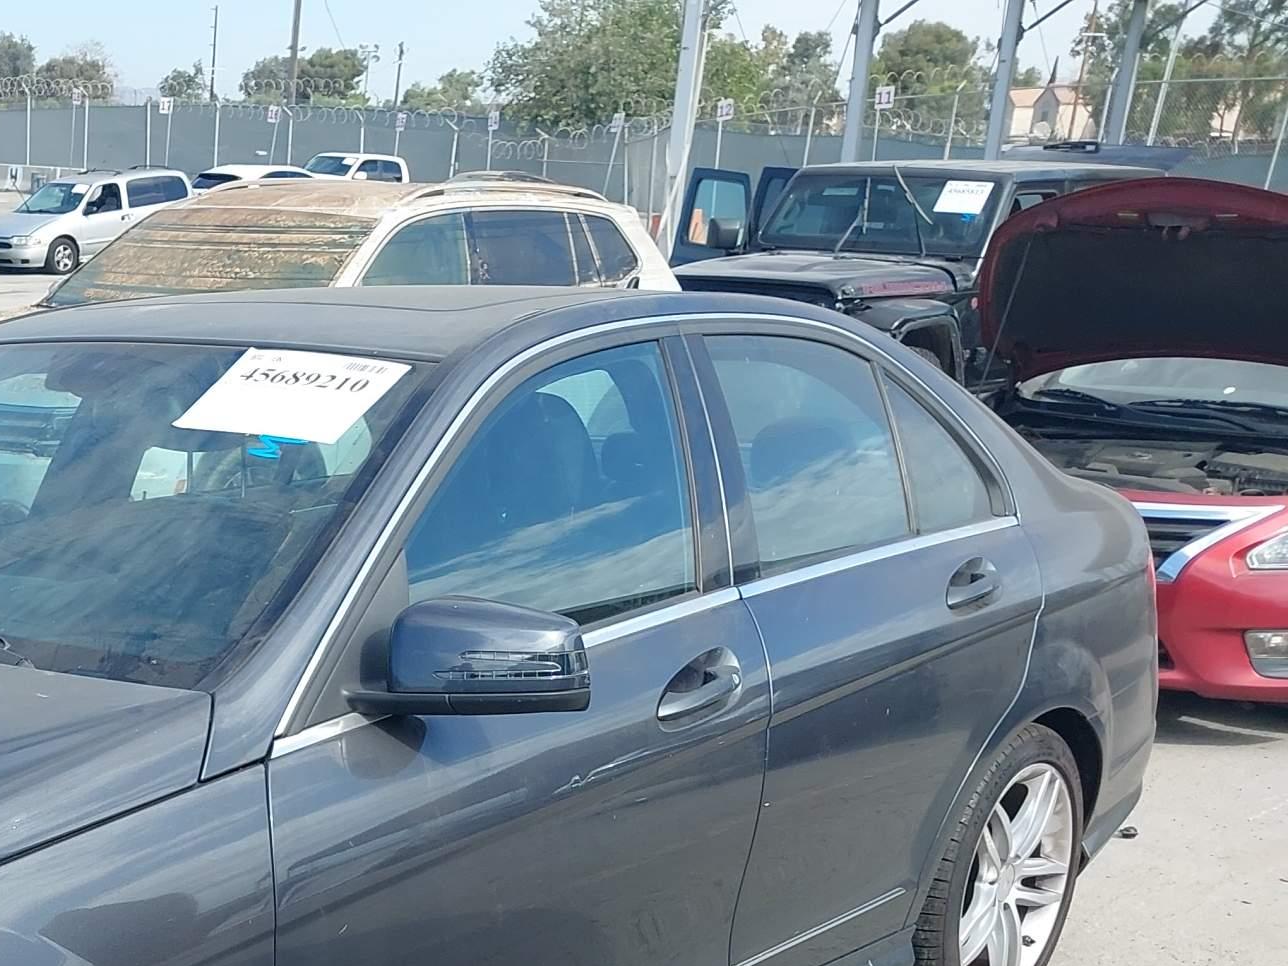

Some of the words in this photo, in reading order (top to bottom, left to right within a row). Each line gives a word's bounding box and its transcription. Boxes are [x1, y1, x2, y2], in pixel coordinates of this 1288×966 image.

[877, 91, 891, 104] 11
[718, 104, 732, 117] 12
[240, 367, 370, 393] 45689210
